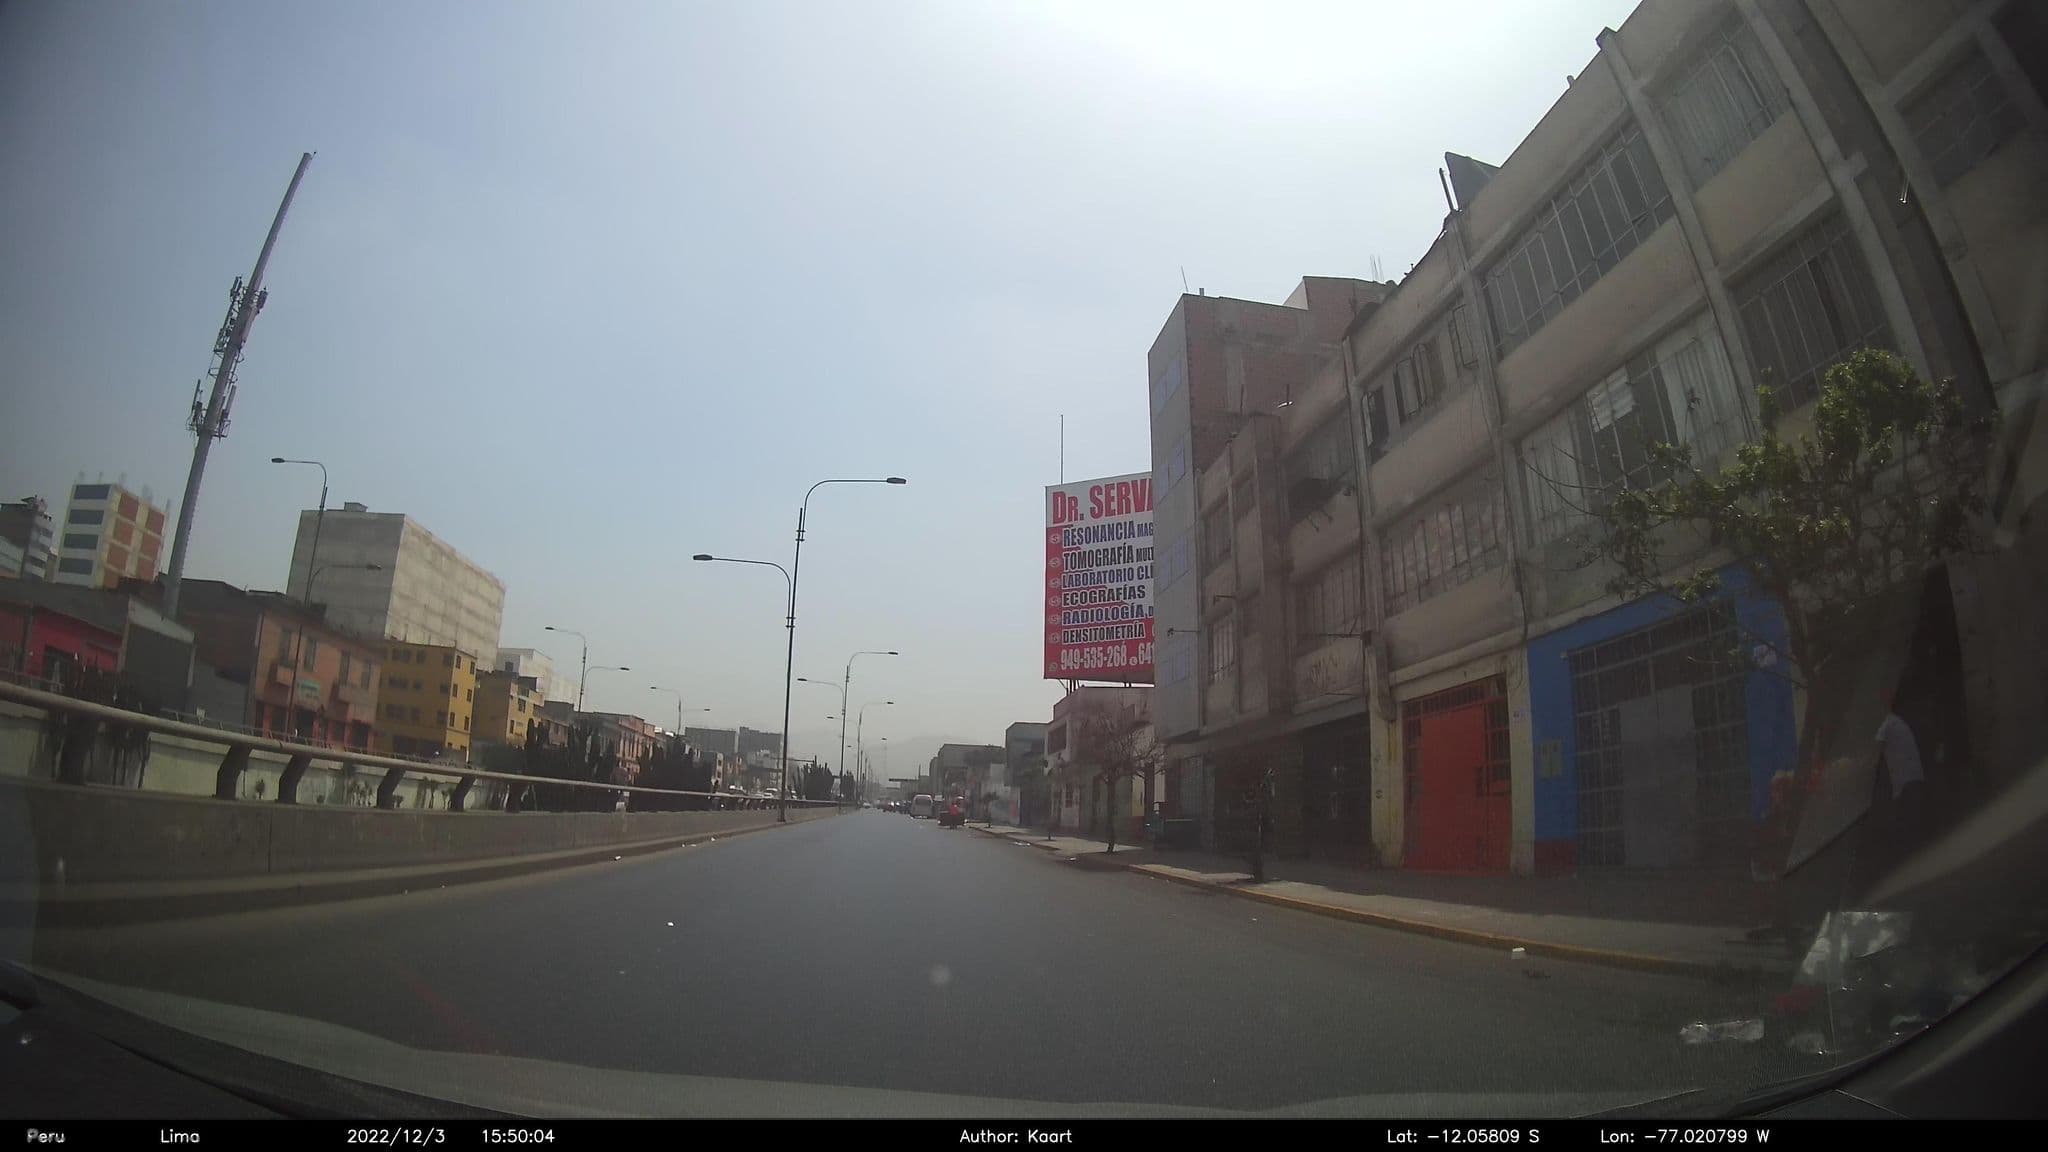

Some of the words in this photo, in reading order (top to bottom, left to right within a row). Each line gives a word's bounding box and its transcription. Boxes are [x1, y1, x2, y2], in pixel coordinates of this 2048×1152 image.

[1063, 520, 1136, 547] RESONANCIA
[1063, 542, 1134, 571] TOMOGRAFÍA
[1062, 567, 1134, 589] LABORATORIO
[1062, 584, 1146, 607] ECOGRAFÍAS
[1062, 622, 1145, 644] DENSITOMETRÍA
[1060, 644, 1127, 671] 949-535-268
